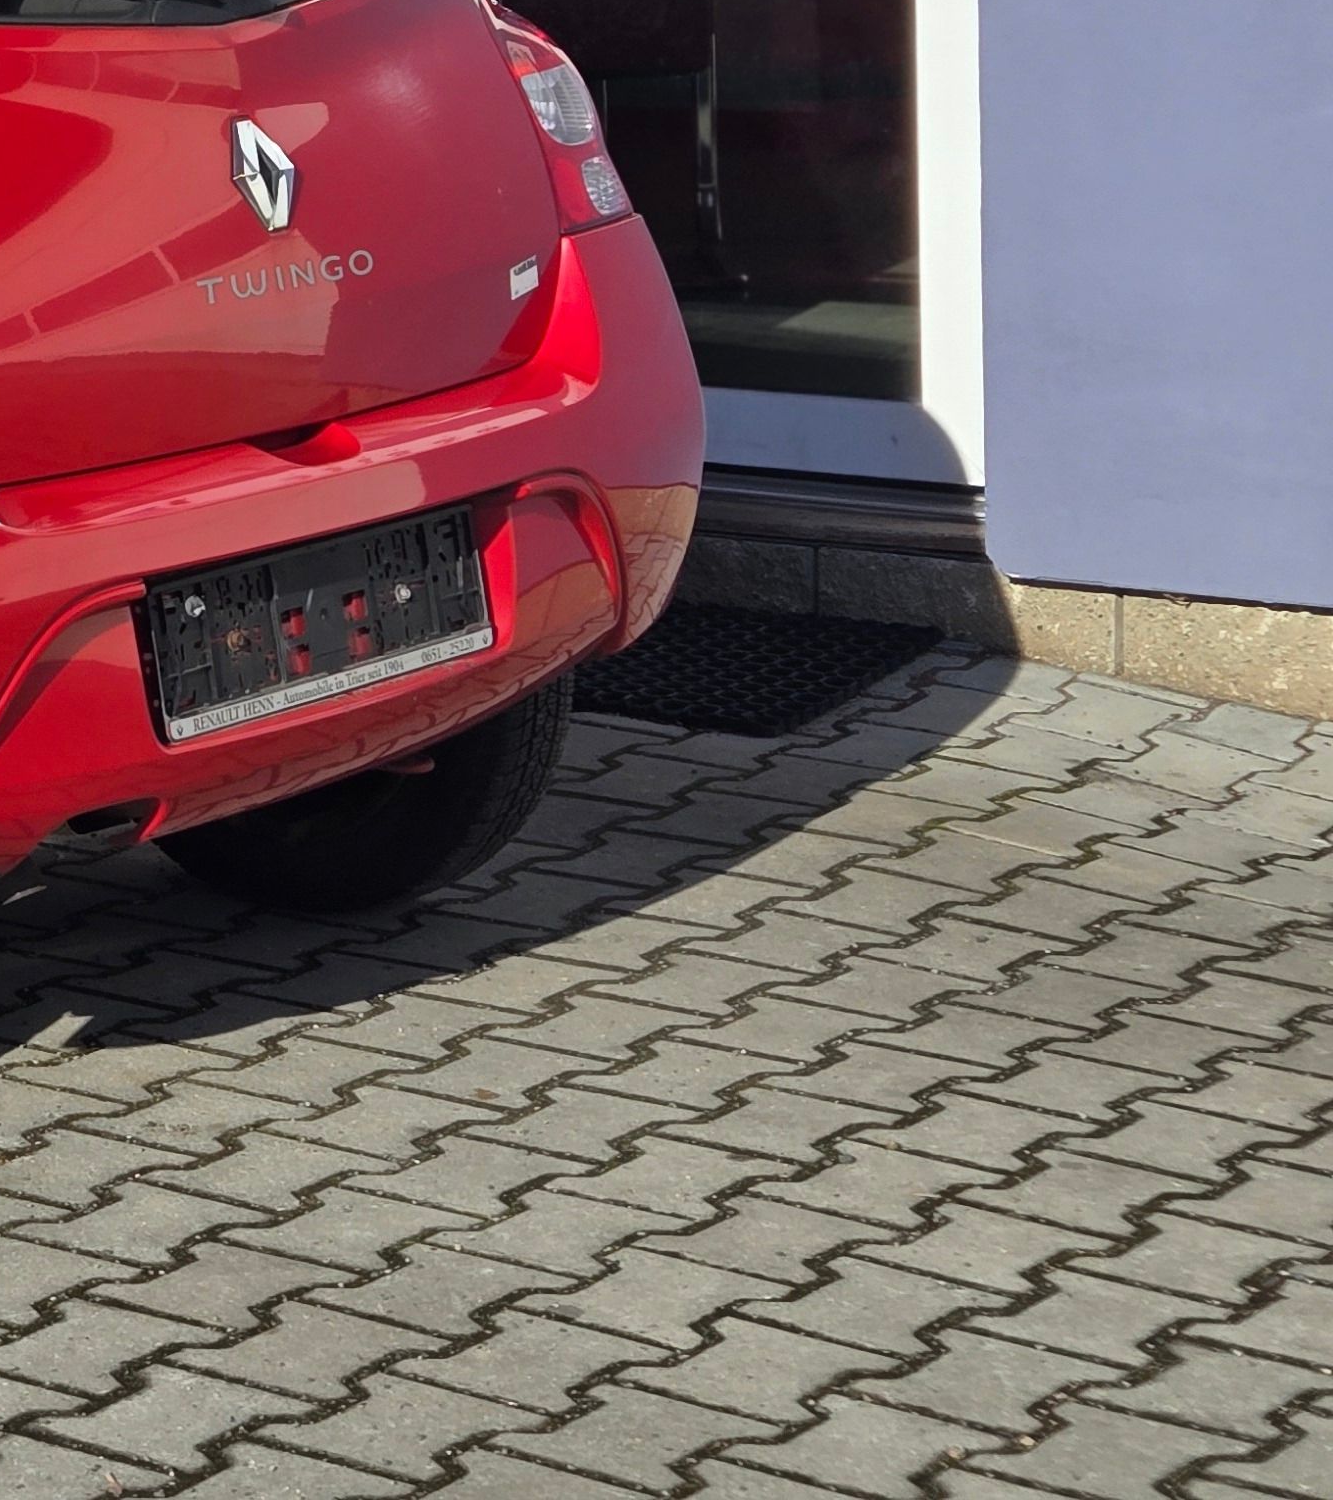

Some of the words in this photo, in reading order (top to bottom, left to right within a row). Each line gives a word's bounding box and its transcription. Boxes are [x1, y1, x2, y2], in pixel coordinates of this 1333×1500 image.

[196, 250, 374, 304] TWINGO
[193, 703, 240, 732] RENAULT
[243, 695, 275, 719] HENN
[283, 680, 334, 706] Automobile
[335, 675, 344, 689] in
[345, 669, 366, 689] Trier
[367, 664, 383, 681] seit
